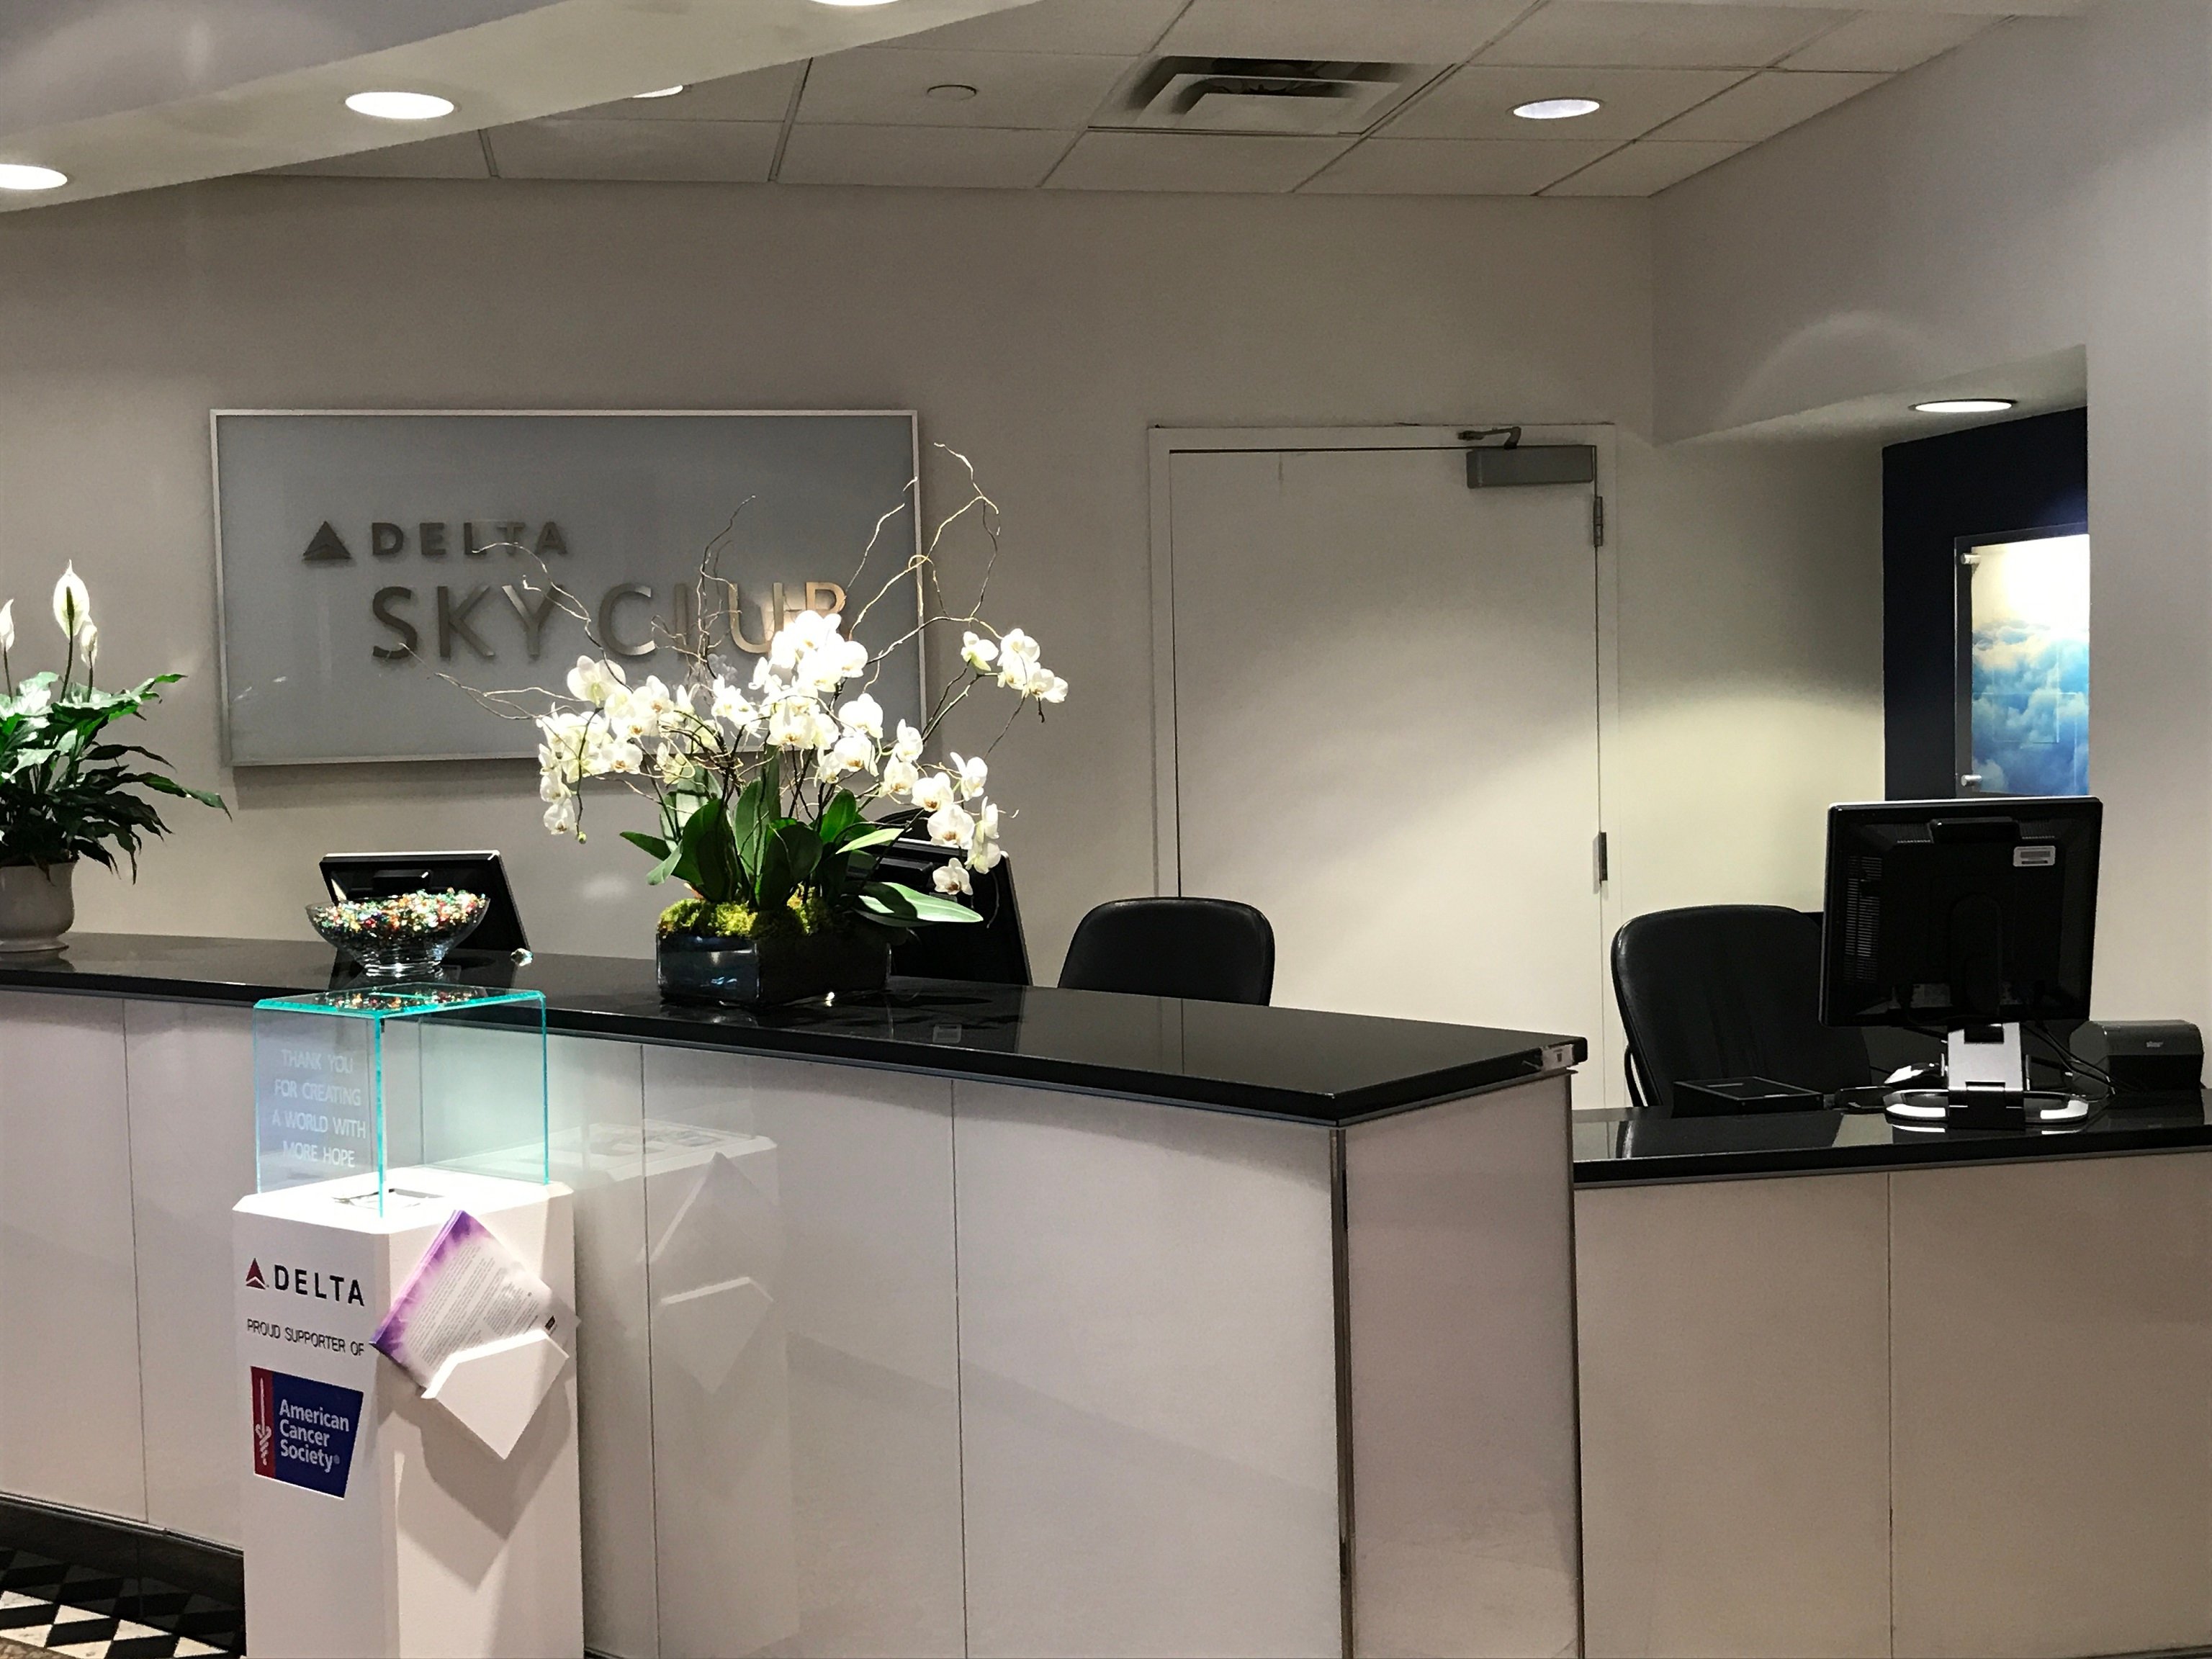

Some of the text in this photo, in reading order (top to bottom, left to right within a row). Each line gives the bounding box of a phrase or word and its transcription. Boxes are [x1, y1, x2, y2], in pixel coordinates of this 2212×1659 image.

[372, 521, 567, 555] DELTA
[372, 585, 563, 660] SKY
[282, 1049, 354, 1074] THANK YOU
[274, 1079, 362, 1106] FOR CREATING
[272, 1109, 366, 1139] A WORLD WITH
[283, 1140, 356, 1168] MORE HOPE
[274, 1264, 364, 1307] DELTA
[247, 1318, 364, 1357] PROUD SUPPORTER OF
[279, 1399, 350, 1432] American
[279, 1419, 331, 1447] Cancer
